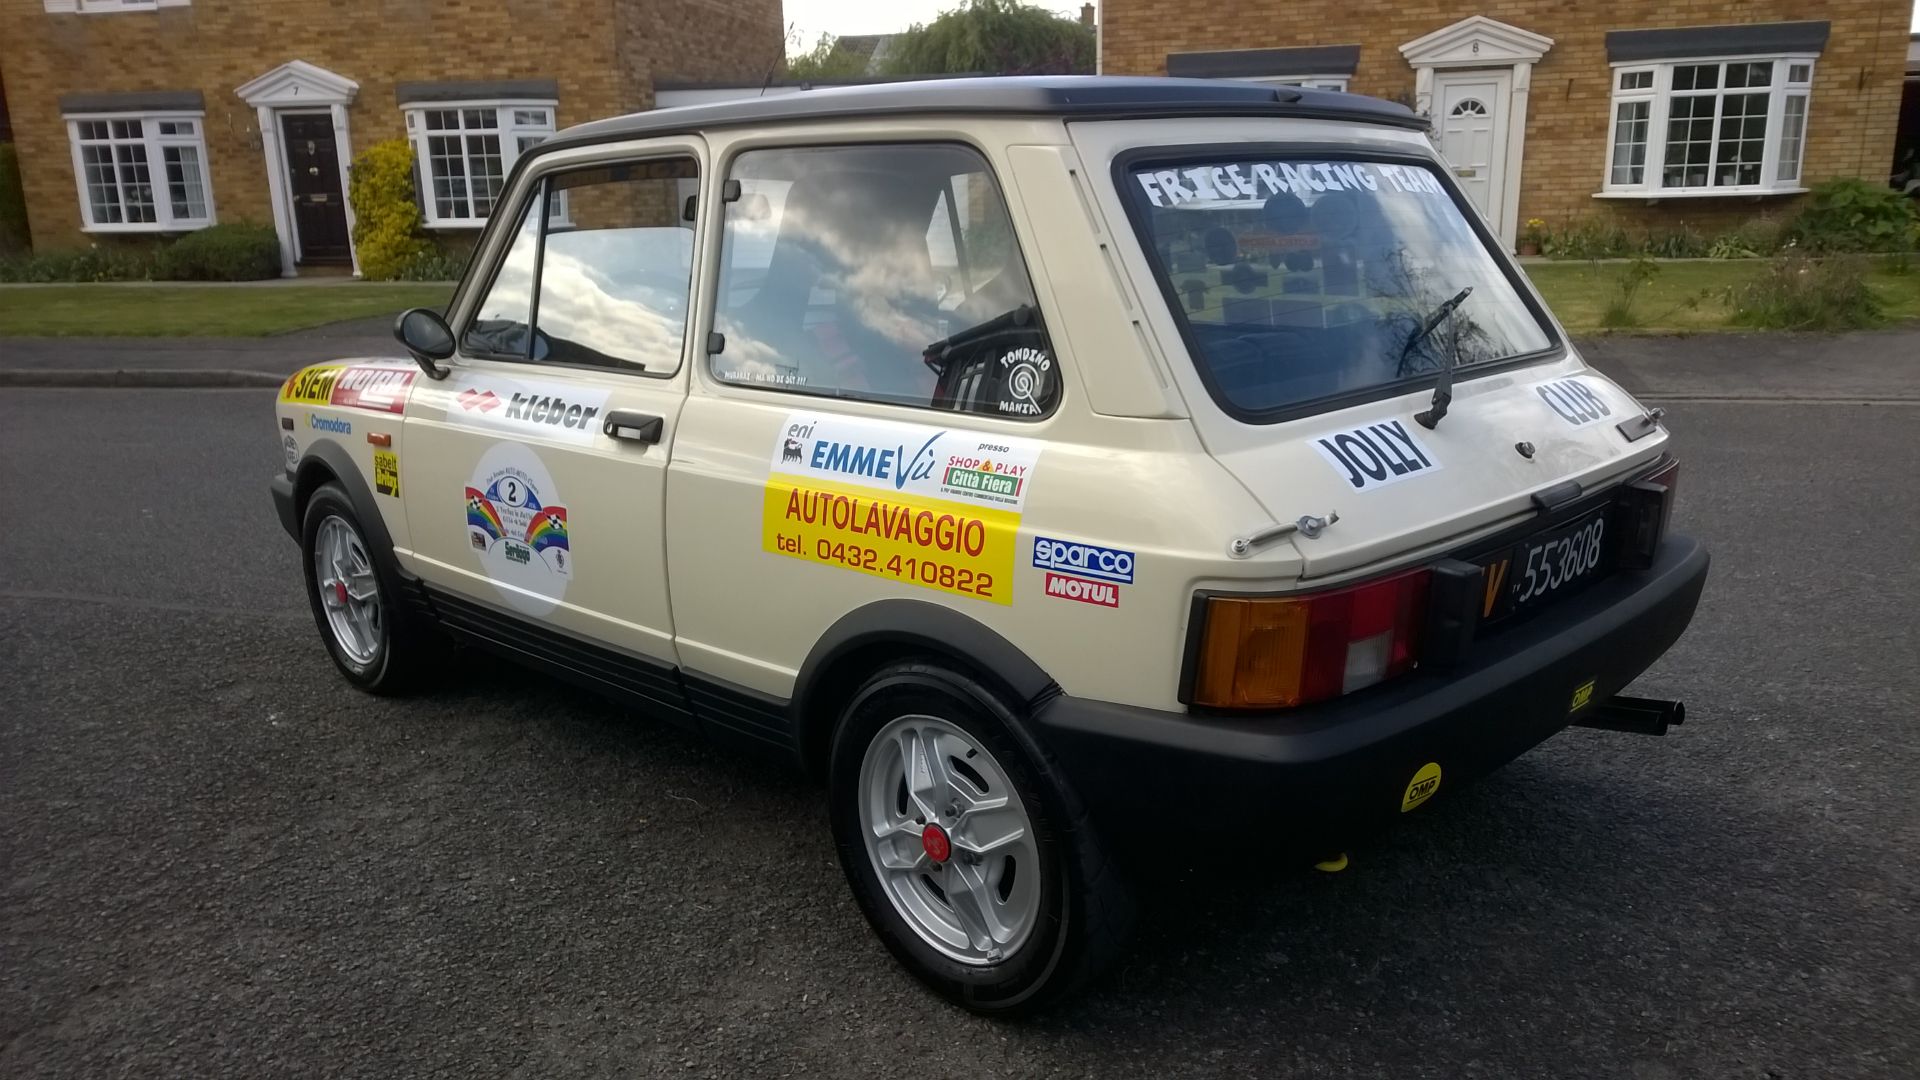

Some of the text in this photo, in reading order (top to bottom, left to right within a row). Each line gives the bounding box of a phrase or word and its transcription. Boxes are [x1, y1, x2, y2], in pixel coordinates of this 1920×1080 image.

[293, 86, 300, 96] 7
[1136, 161, 1448, 207] FRICE RACING TEAM
[1000, 347, 1051, 371] TONDINO
[295, 368, 336, 401] SIEM
[999, 400, 1039, 415] MANIA
[1535, 379, 1612, 425] CLUB
[311, 414, 352, 434] Cromodora
[788, 421, 818, 439] eni
[977, 443, 1010, 453] presso
[1318, 420, 1433, 488] JOLLY
[374, 453, 398, 471] sabelt
[948, 456, 1027, 477] SHOP & PLAY
[508, 481, 517, 502] 2
[951, 470, 1013, 494] Città Fiera
[785, 487, 985, 557] AUTOLAVAGGIO
[777, 533, 993, 597] tel. 0432.410822
[1035, 540, 1132, 574] sparco
[1518, 518, 1604, 602] 553608
[1048, 576, 1117, 604] MOTUL
[1571, 685, 1594, 708] OMP
[1408, 779, 1437, 801] OMP
